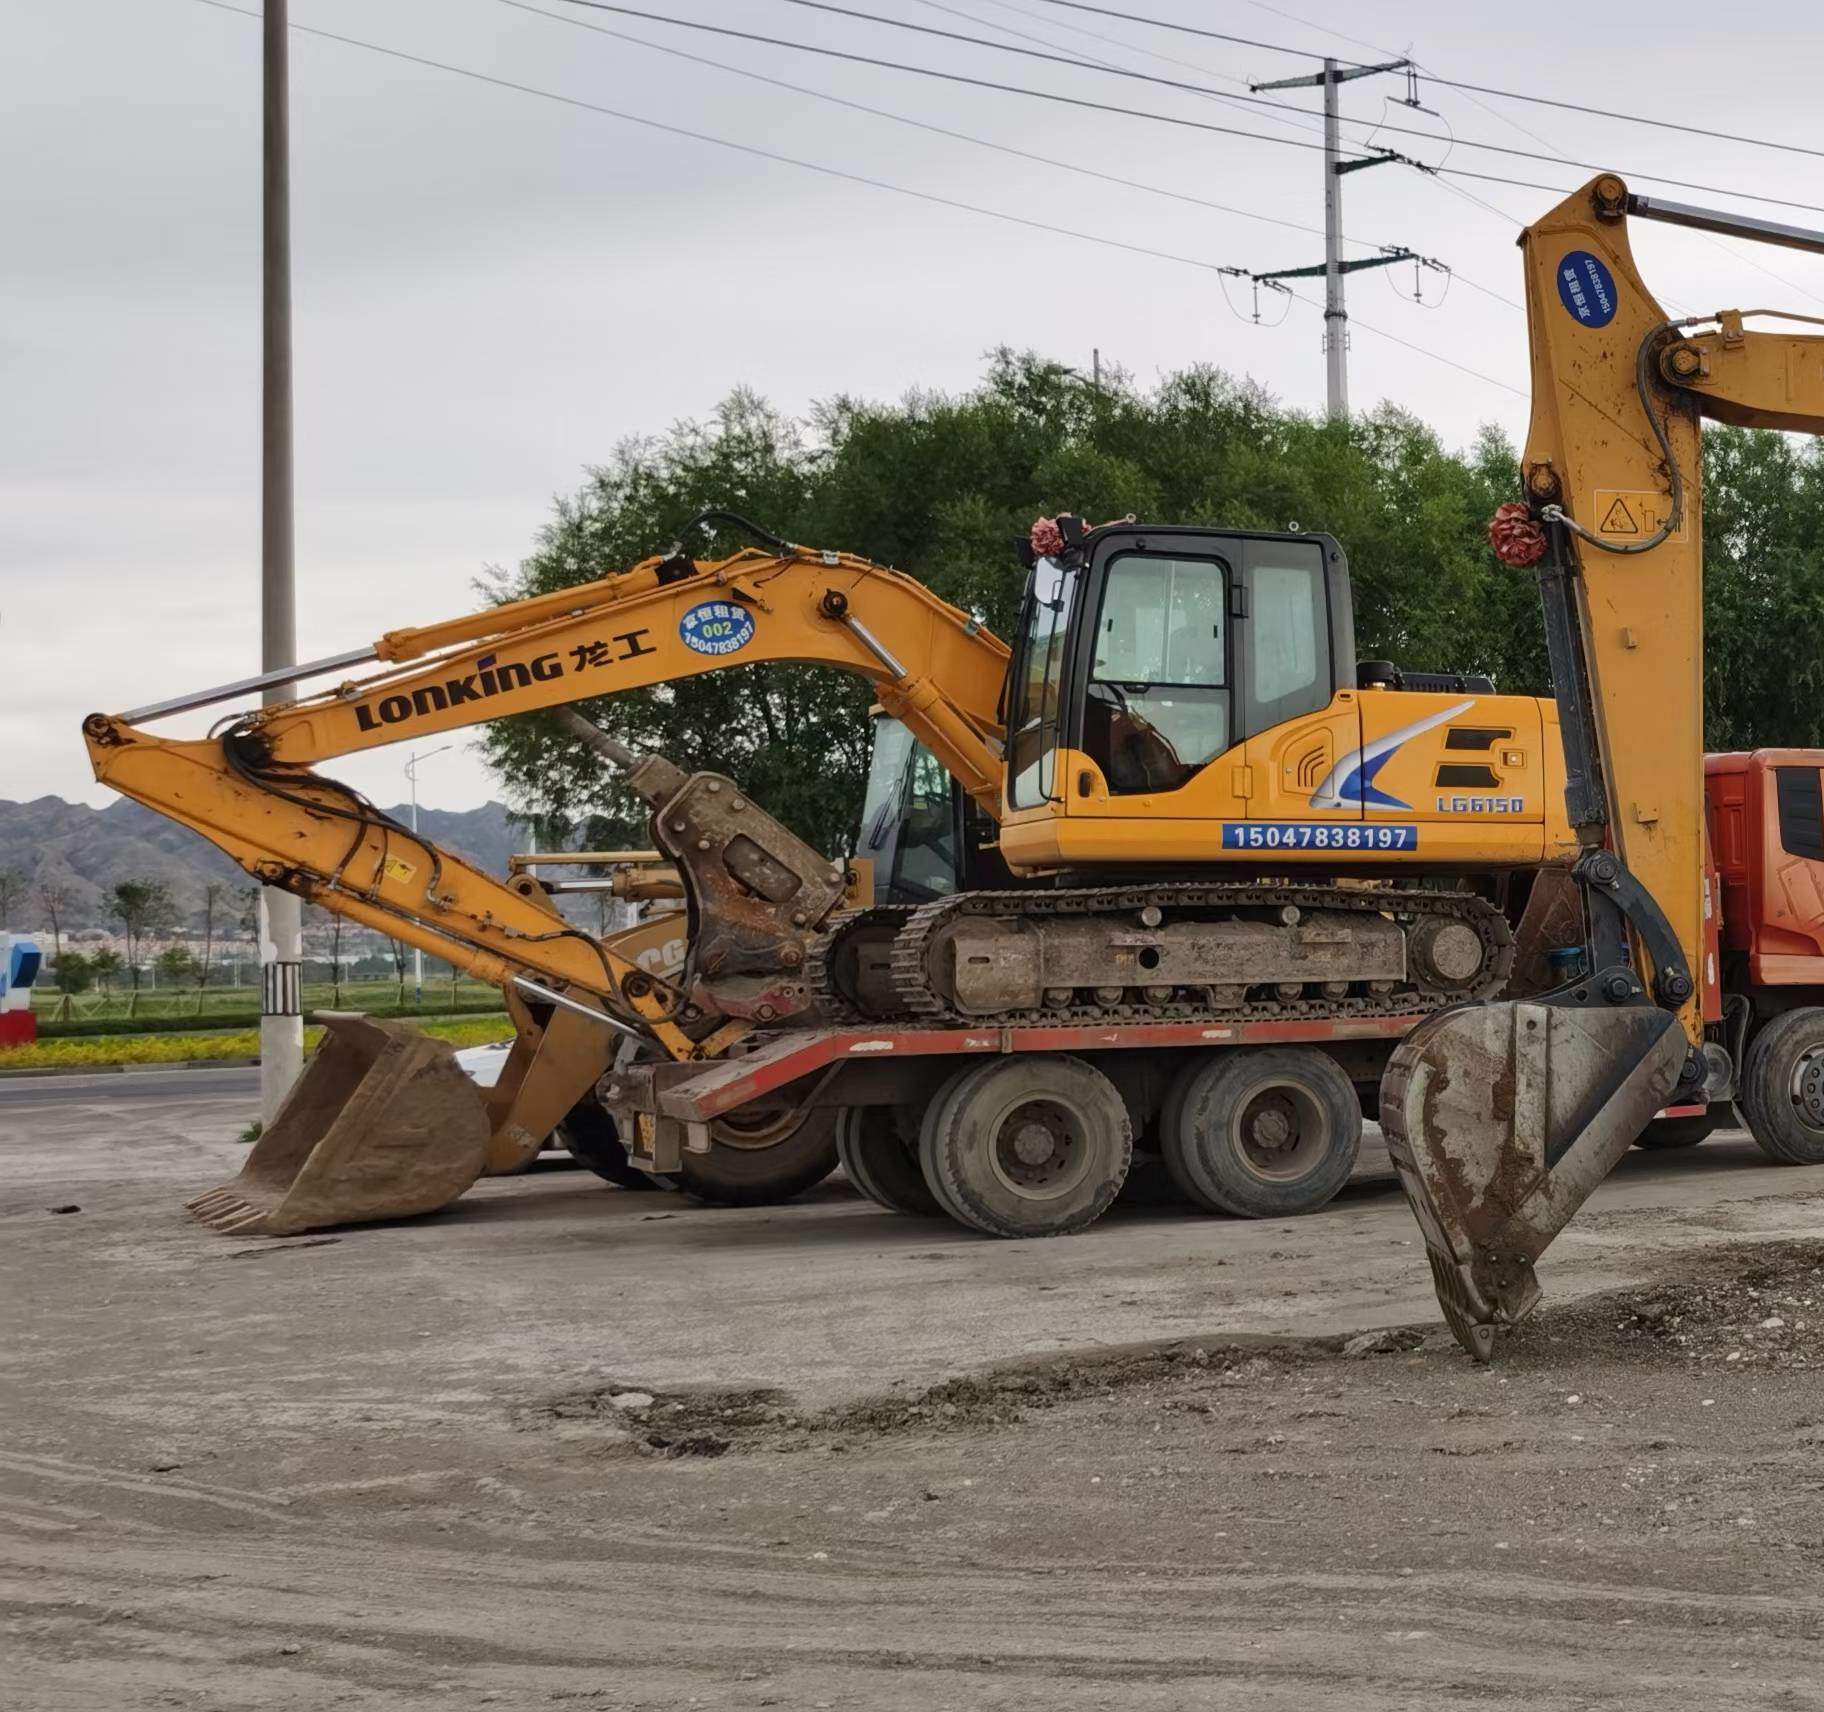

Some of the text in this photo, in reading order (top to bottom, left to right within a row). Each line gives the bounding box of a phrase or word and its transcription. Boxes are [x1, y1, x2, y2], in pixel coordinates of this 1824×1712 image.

[702, 621, 733, 638] 002
[569, 628, 657, 672] 龙工
[1233, 827, 1408, 848] 15047838197
